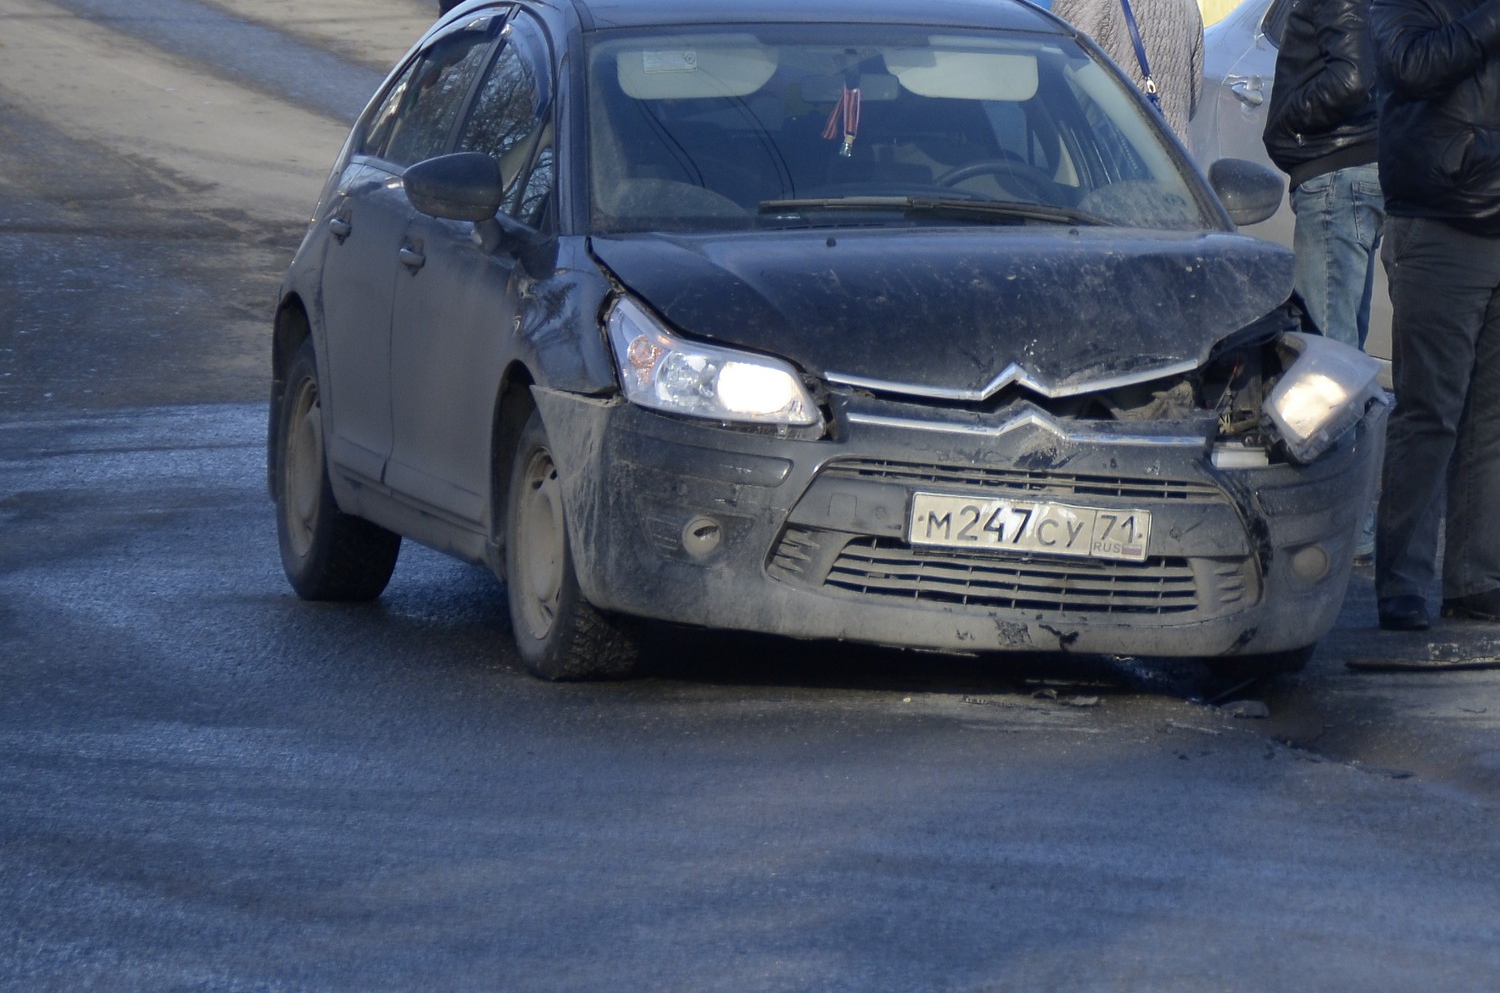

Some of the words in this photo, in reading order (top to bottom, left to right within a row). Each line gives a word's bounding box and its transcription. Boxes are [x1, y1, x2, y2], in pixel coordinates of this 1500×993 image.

[925, 504, 1085, 548] М247СУ
[1100, 514, 1134, 543] 71
[1092, 542, 1121, 554] RUS
